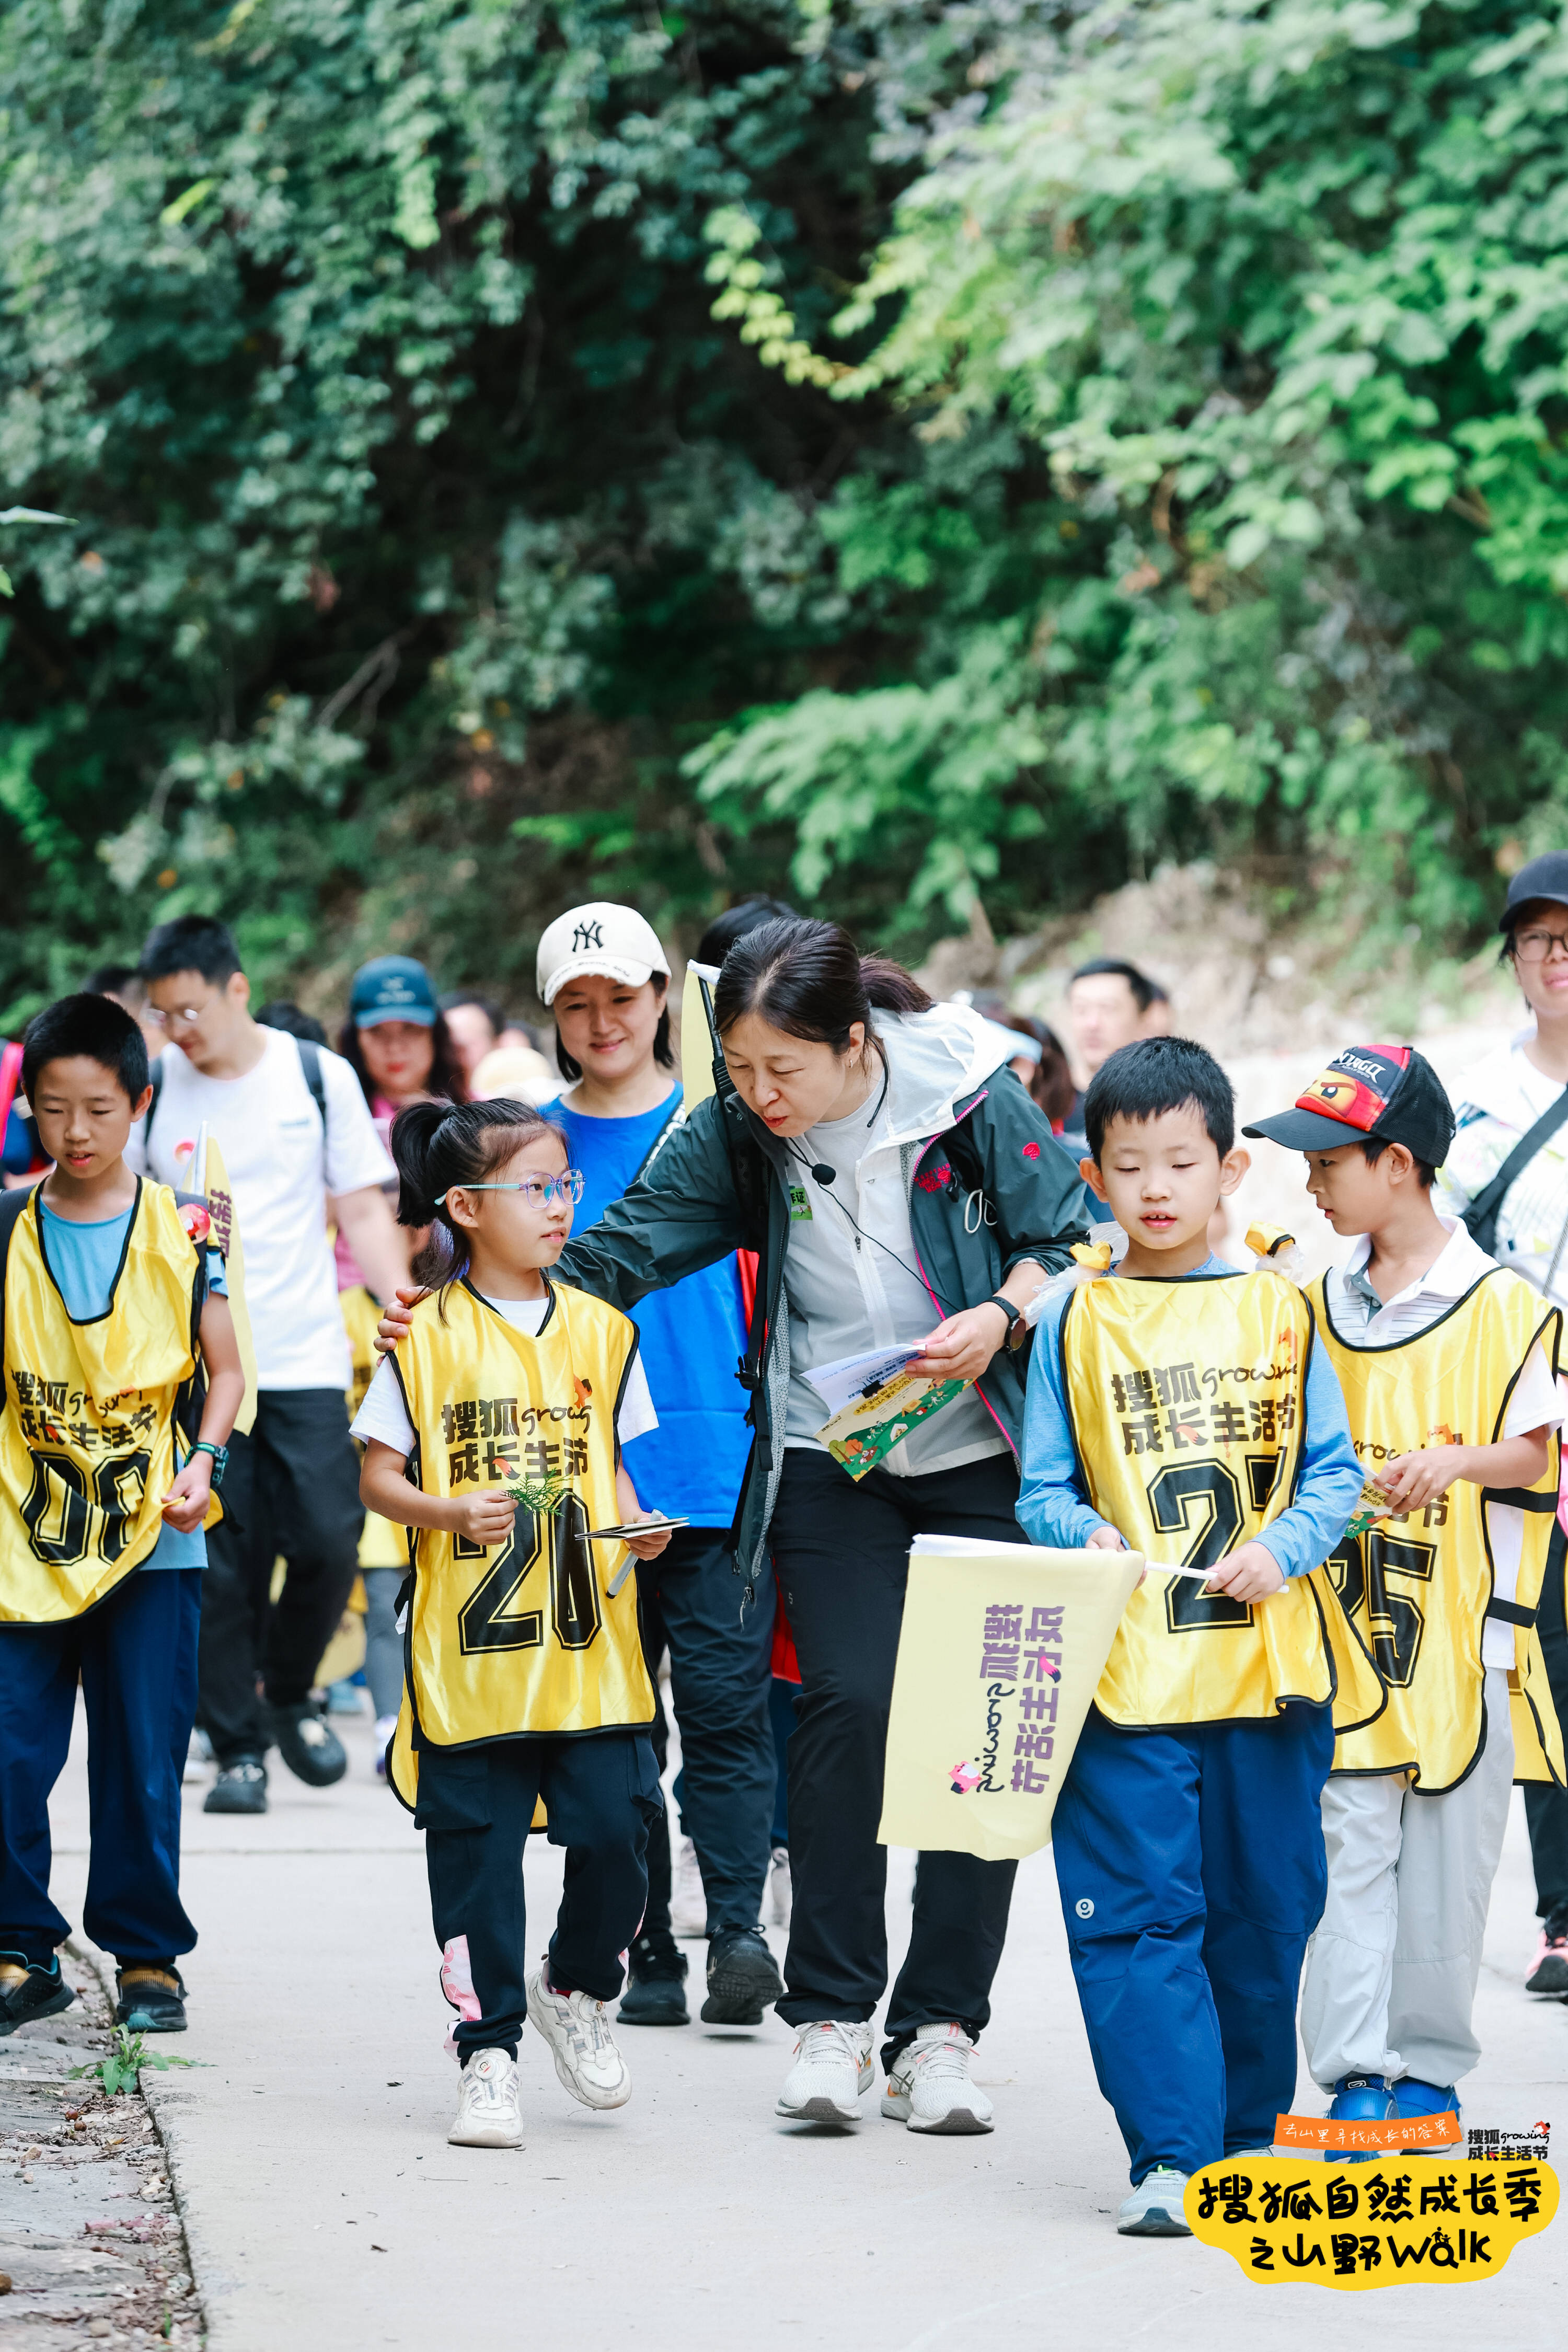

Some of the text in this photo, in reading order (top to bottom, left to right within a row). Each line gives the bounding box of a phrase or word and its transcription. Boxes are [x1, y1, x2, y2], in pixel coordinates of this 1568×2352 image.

[572, 919, 603, 952] NY
[1111, 1362, 1202, 1413] 搜狐
[441, 1398, 520, 1445] 搜狐
[453, 1488, 603, 1656] 20
